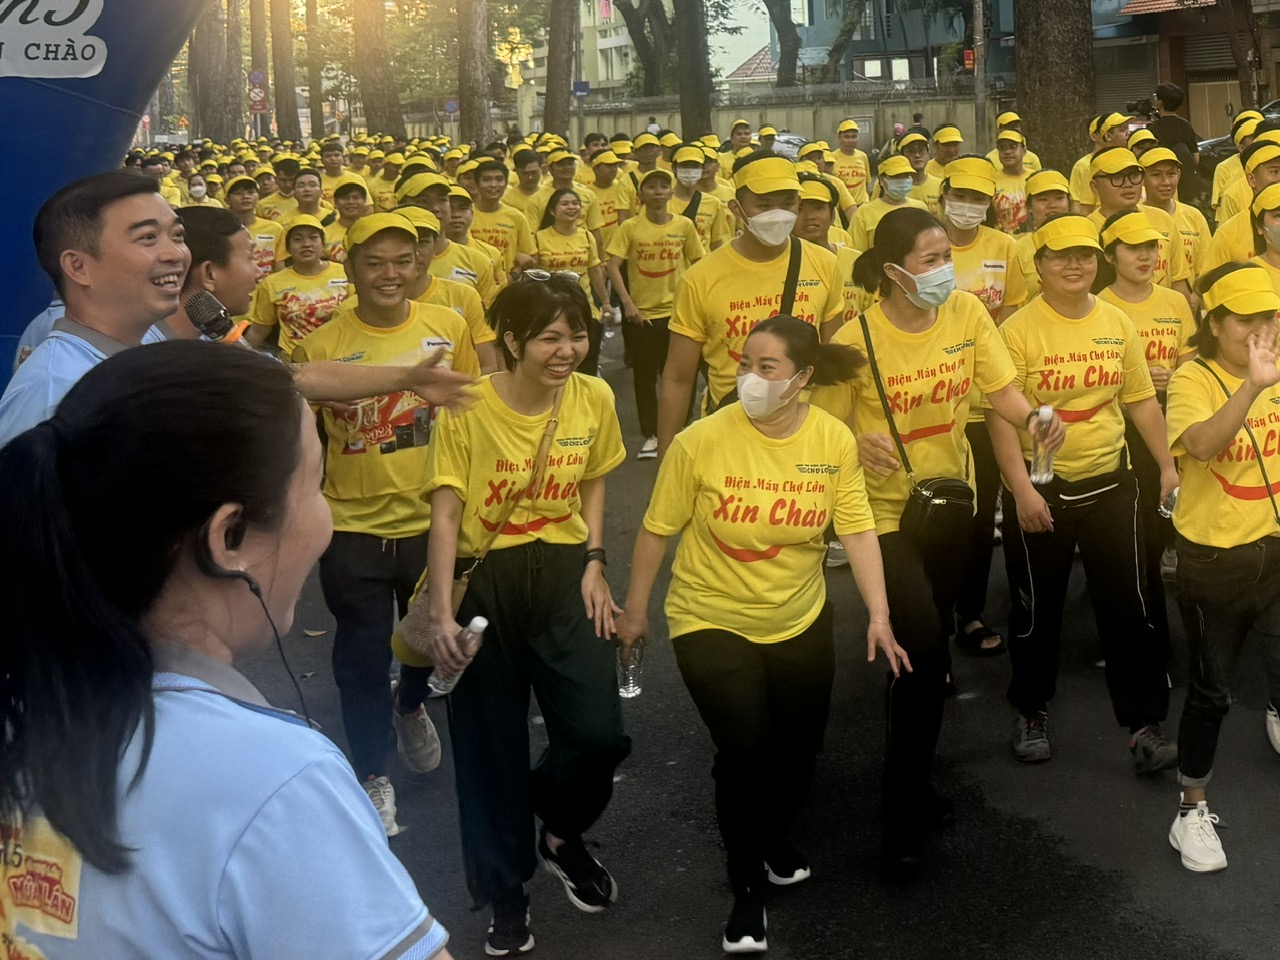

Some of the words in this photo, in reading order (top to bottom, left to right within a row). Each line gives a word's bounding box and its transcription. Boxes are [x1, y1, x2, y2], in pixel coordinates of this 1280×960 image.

[24, 38, 96, 61] CHÀO
[729, 299, 750, 311] Điện
[752, 294, 773, 309] Máy
[1044, 354, 1065, 366] Điện
[1066, 351, 1087, 364] Máy
[1089, 349, 1105, 361] Chợ
[887, 373, 912, 388] Điện
[914, 368, 937, 381] Máy
[1036, 368, 1076, 392] Xin
[886, 390, 924, 415] Xin
[724, 475, 750, 489] Điện
[753, 477, 779, 493] Máy
[782, 480, 803, 495] Chợ
[806, 481, 825, 493] Lớn
[713, 494, 760, 524] Xin
[769, 497, 827, 528] Chào
